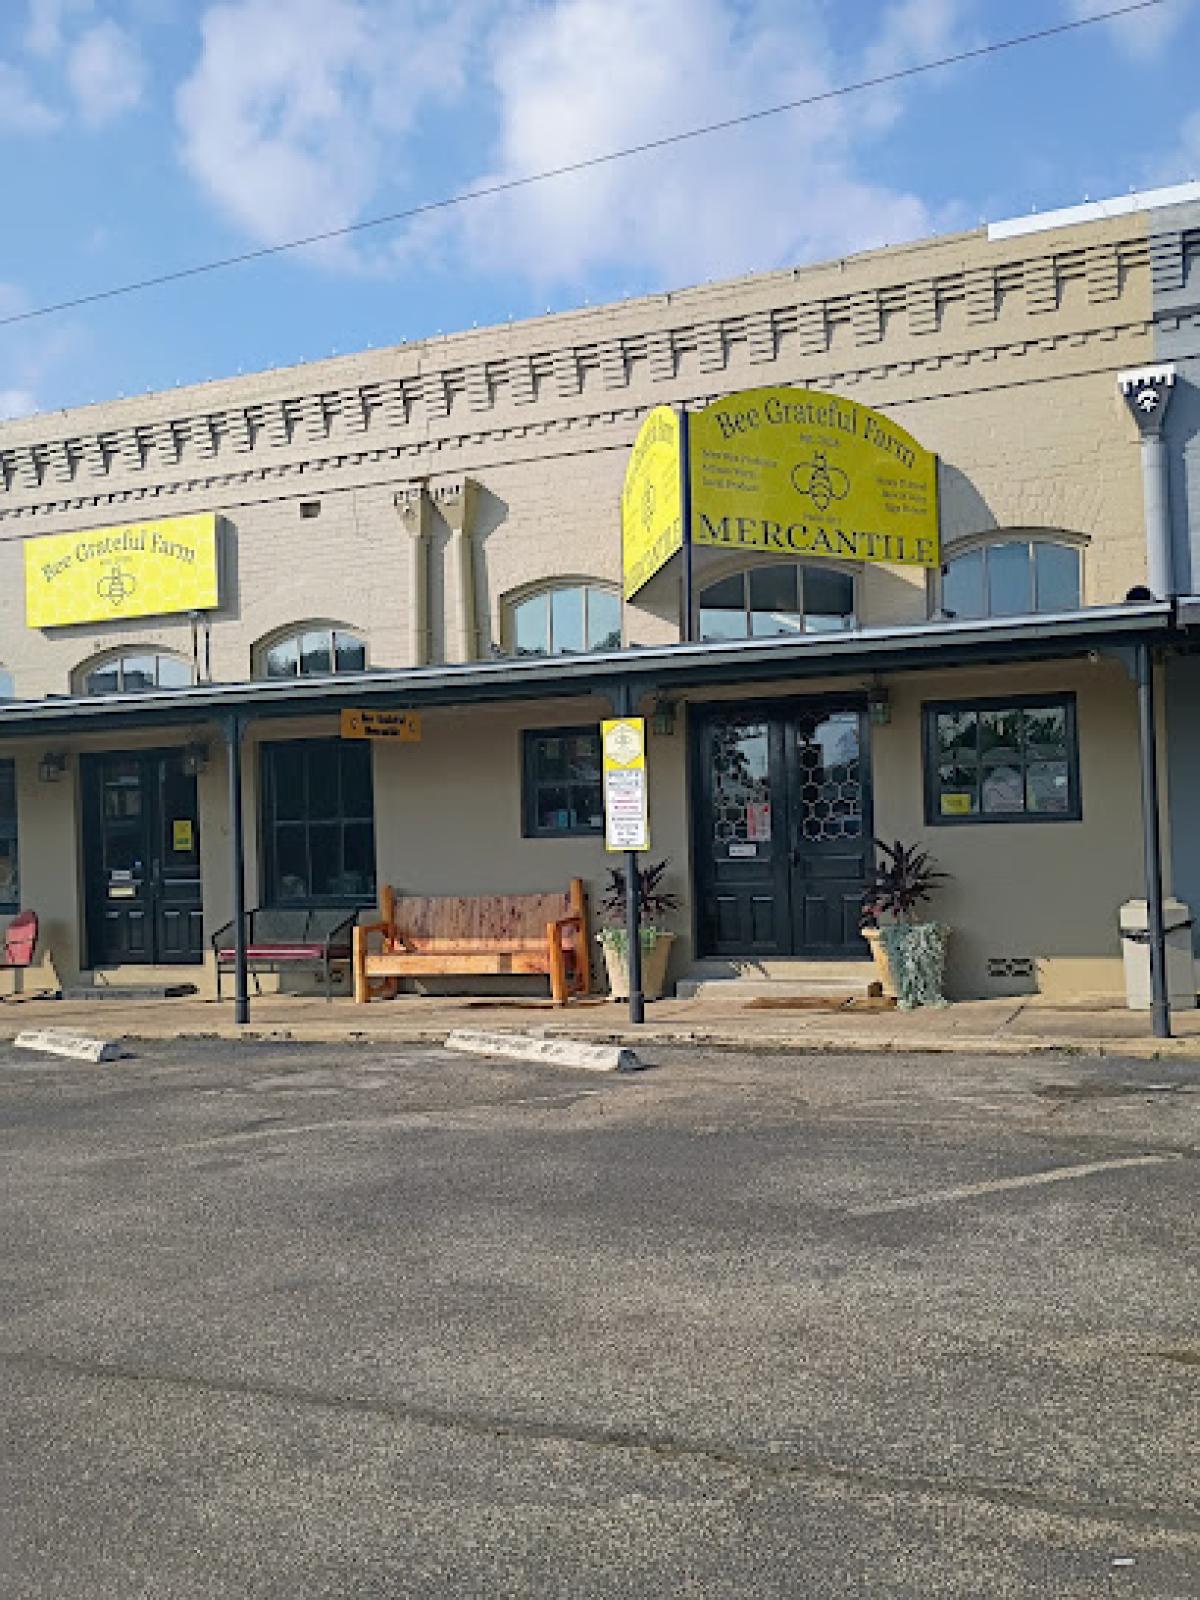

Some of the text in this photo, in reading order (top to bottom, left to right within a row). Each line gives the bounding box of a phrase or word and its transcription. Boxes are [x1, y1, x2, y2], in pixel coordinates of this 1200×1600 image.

[715, 397, 915, 469] Bee Grateful Farm
[41, 529, 194, 582] Bee Grateful Farm
[699, 513, 934, 563] MERCANTILE
